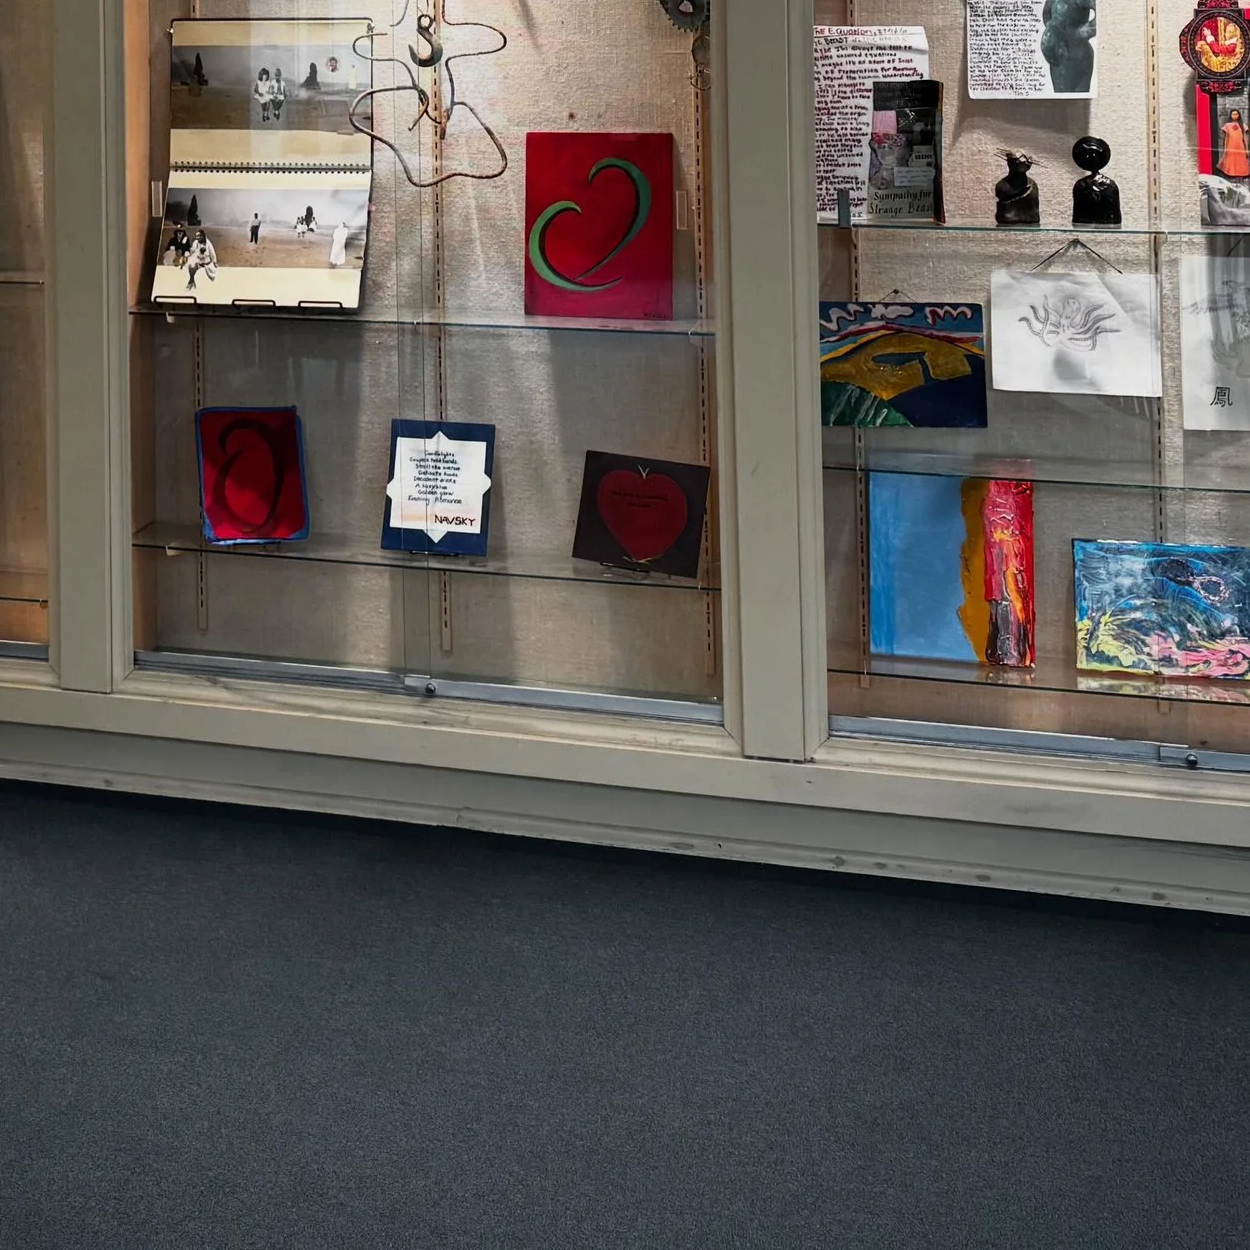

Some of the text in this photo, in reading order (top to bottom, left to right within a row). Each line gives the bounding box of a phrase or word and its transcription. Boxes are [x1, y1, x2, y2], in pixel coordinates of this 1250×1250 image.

[873, 189, 933, 204] Sympathy for
[868, 202, 903, 218] Strange
[1210, 386, 1234, 407] 鳳
[434, 514, 476, 527] NAVSKY
